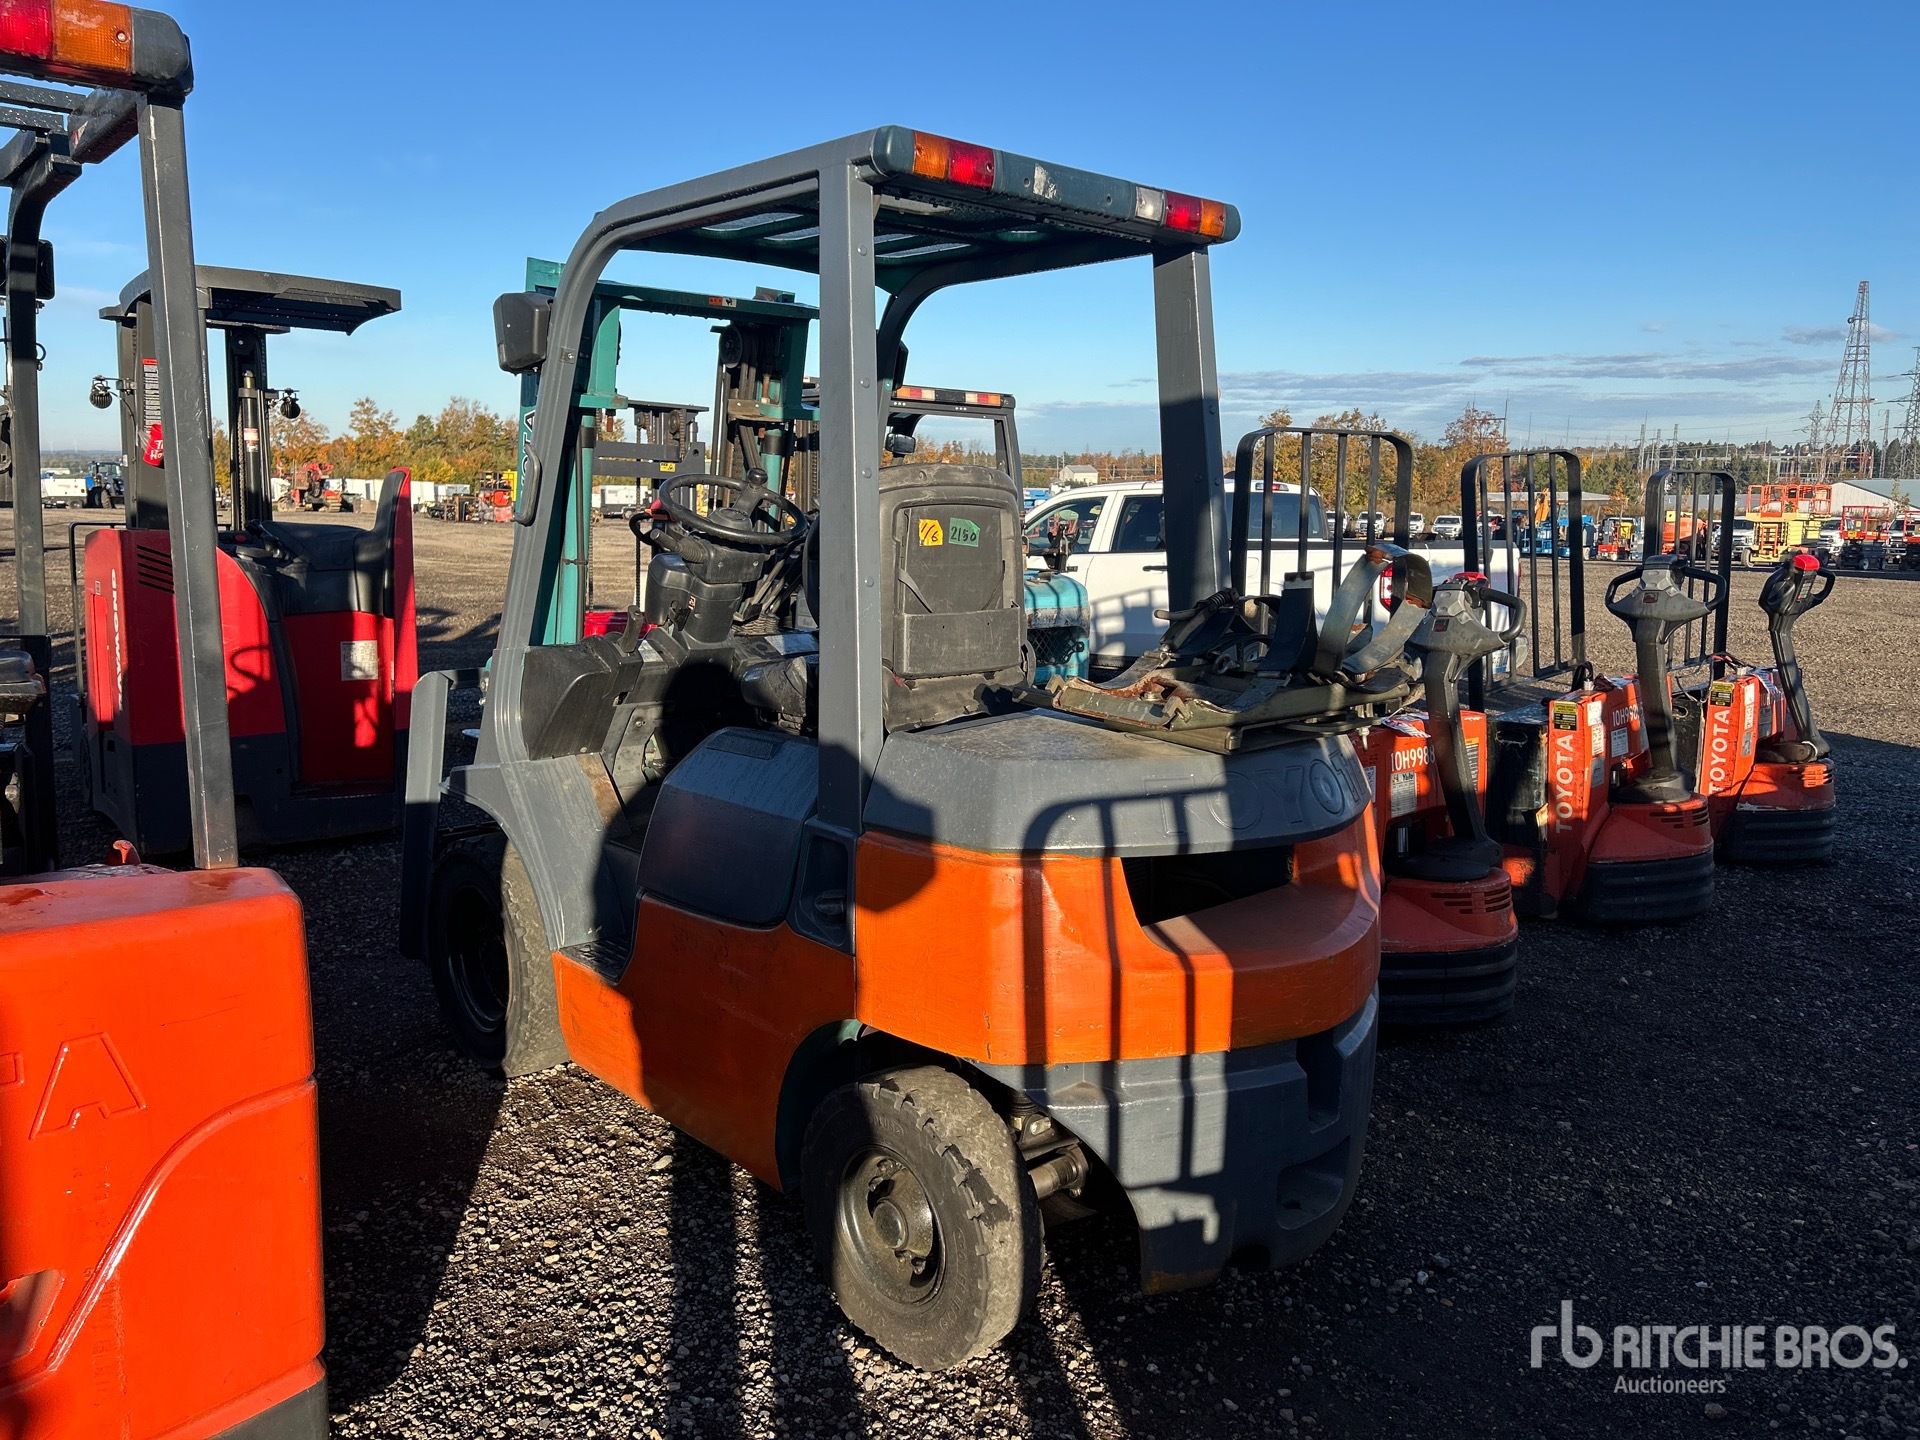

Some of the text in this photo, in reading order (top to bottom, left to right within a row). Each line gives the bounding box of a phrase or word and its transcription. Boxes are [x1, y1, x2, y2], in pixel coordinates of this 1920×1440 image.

[950, 526, 977, 542] 2150
[111, 568, 123, 712] RAYMOND
[1390, 744, 1436, 772] 10H9988
[1555, 734, 1574, 834] TOYOTA
[1708, 709, 1731, 794] TOYOTA
